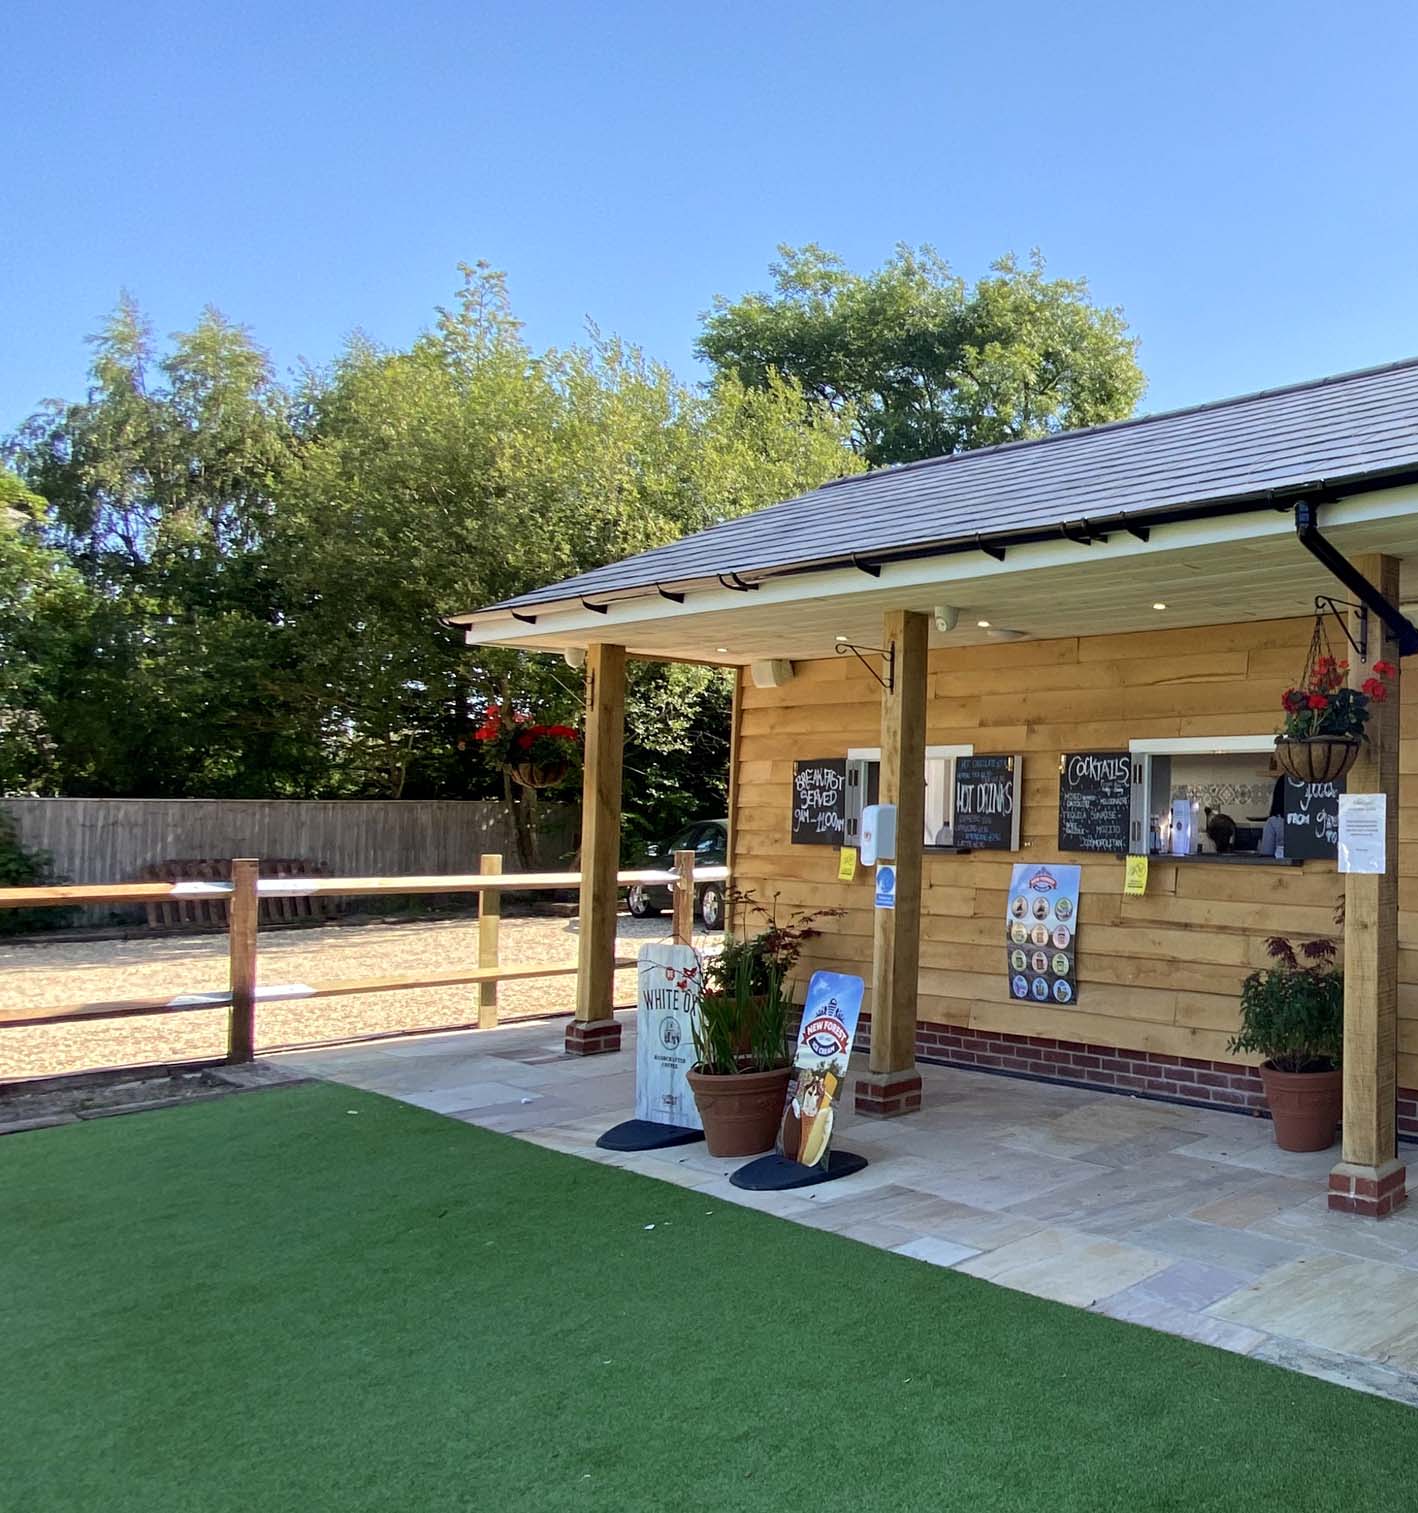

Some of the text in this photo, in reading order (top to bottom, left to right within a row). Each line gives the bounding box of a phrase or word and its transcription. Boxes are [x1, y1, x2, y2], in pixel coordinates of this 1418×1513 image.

[795, 767, 846, 791] BREAKFAST
[1068, 755, 1131, 788] COCKTAILS
[800, 788, 838, 809] SERVED
[956, 781, 1013, 817] HOT DRINKS
[643, 988, 680, 1011] WHITE
[807, 1020, 847, 1041] NEW FOREST
